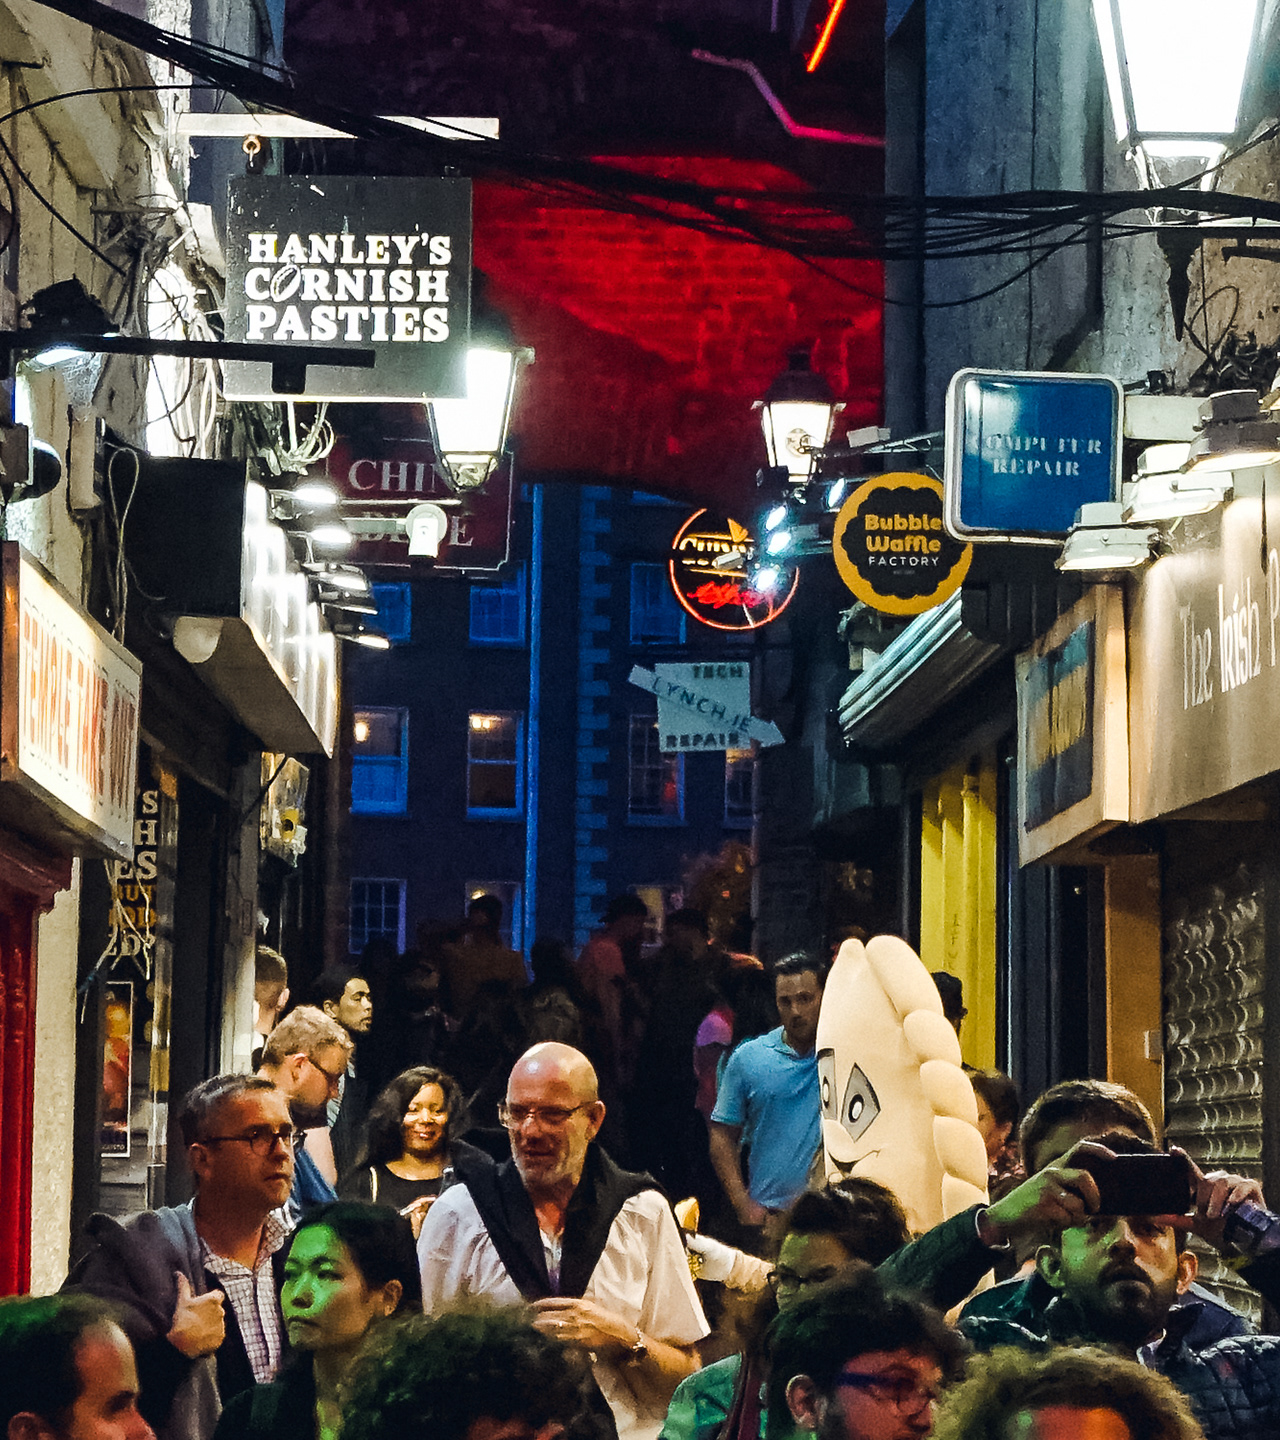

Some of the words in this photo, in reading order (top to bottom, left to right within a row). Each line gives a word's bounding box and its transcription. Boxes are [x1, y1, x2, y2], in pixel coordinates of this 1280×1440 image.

[247, 232, 453, 266] HANLEY'S
[244, 266, 451, 303] CORNISH
[245, 304, 451, 343] PASTIES
[992, 458, 1080, 477] REPAIR
[864, 513, 942, 531] Bubble
[865, 534, 942, 554] Waffle
[868, 556, 940, 567] FACTORY
[23, 608, 73, 765] TEMPLE
[76, 657, 110, 802] TAKE
[109, 685, 137, 820] OUT
